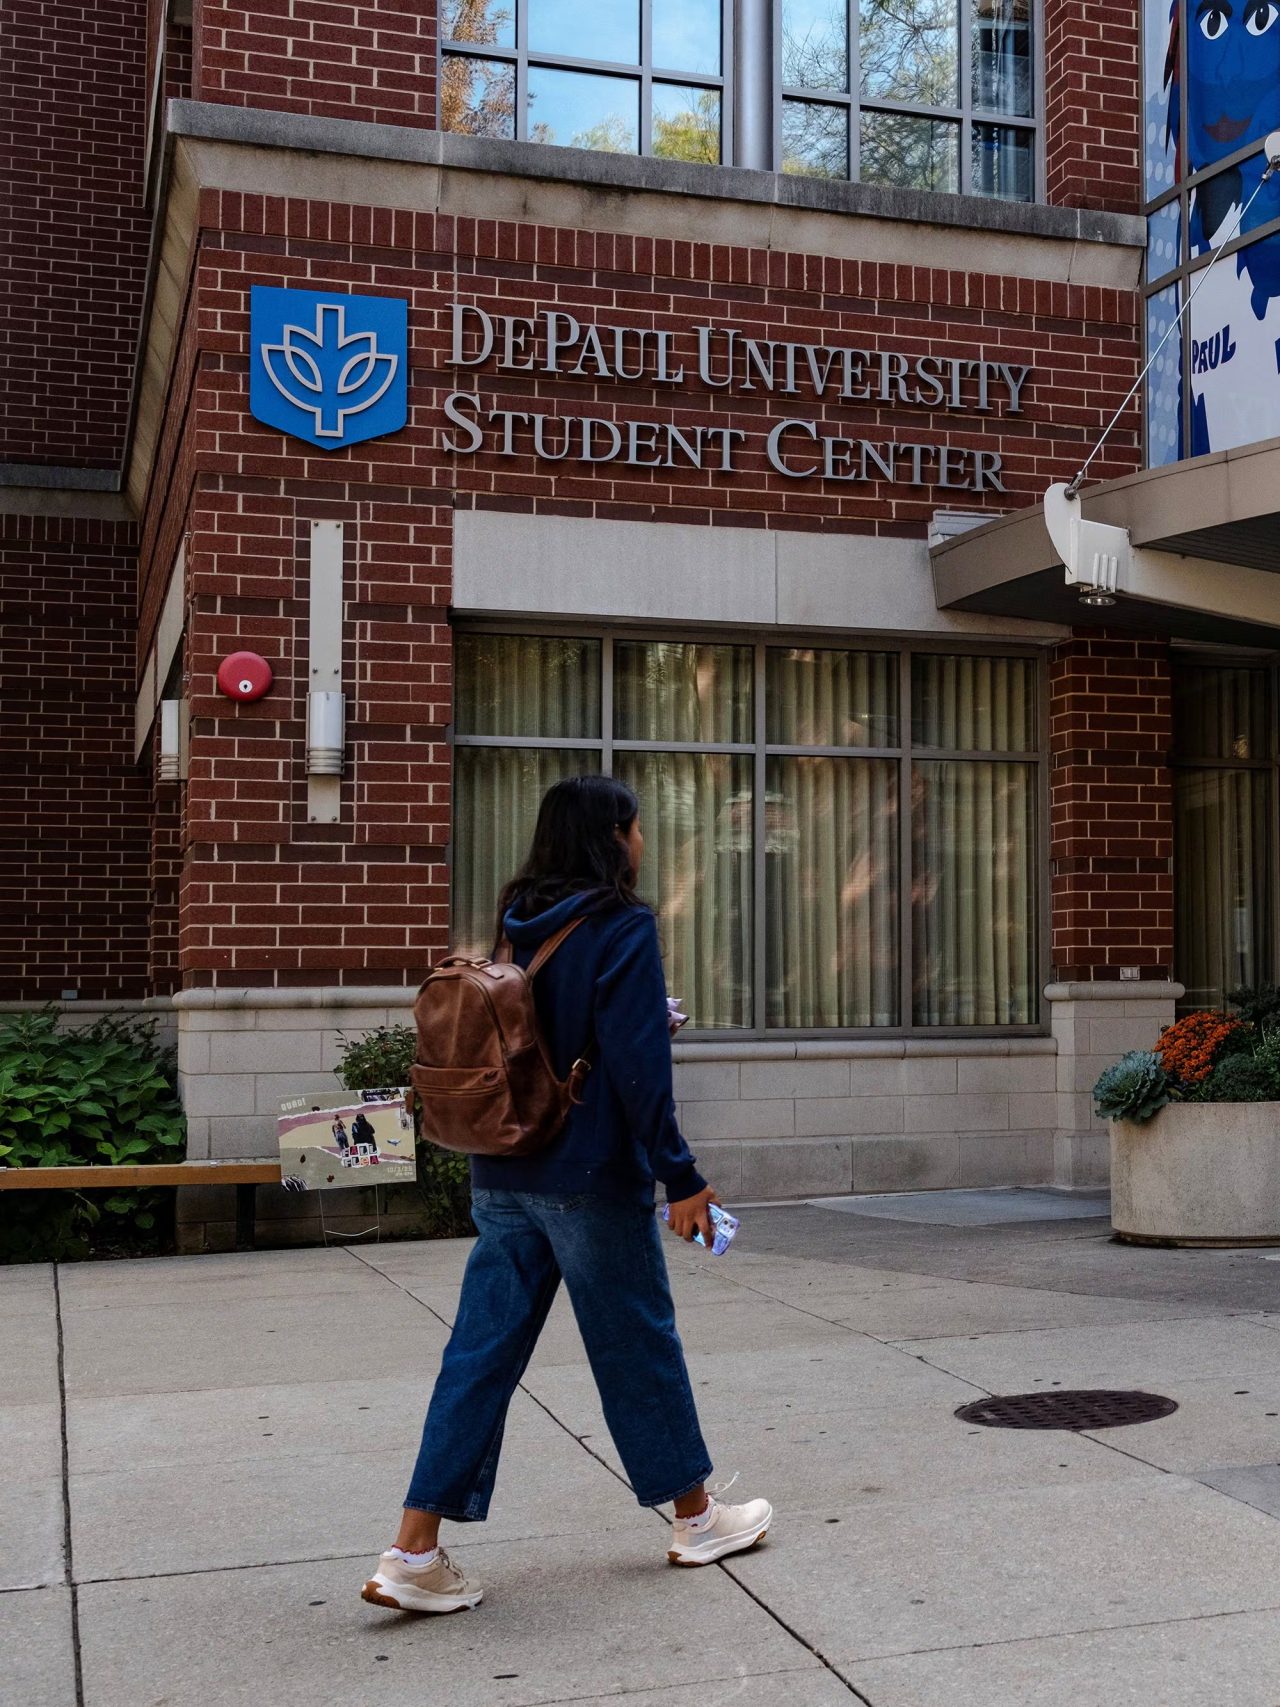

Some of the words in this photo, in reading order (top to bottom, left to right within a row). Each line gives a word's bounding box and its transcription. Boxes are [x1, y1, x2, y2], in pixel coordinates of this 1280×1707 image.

[444, 304, 684, 383] DEPAUL
[692, 326, 1032, 413] UNIVERSITY
[1192, 324, 1236, 374] PAUL
[441, 392, 745, 472] STUDENT
[767, 419, 1008, 492] CENTER
[342, 1145, 378, 1158] FALL
